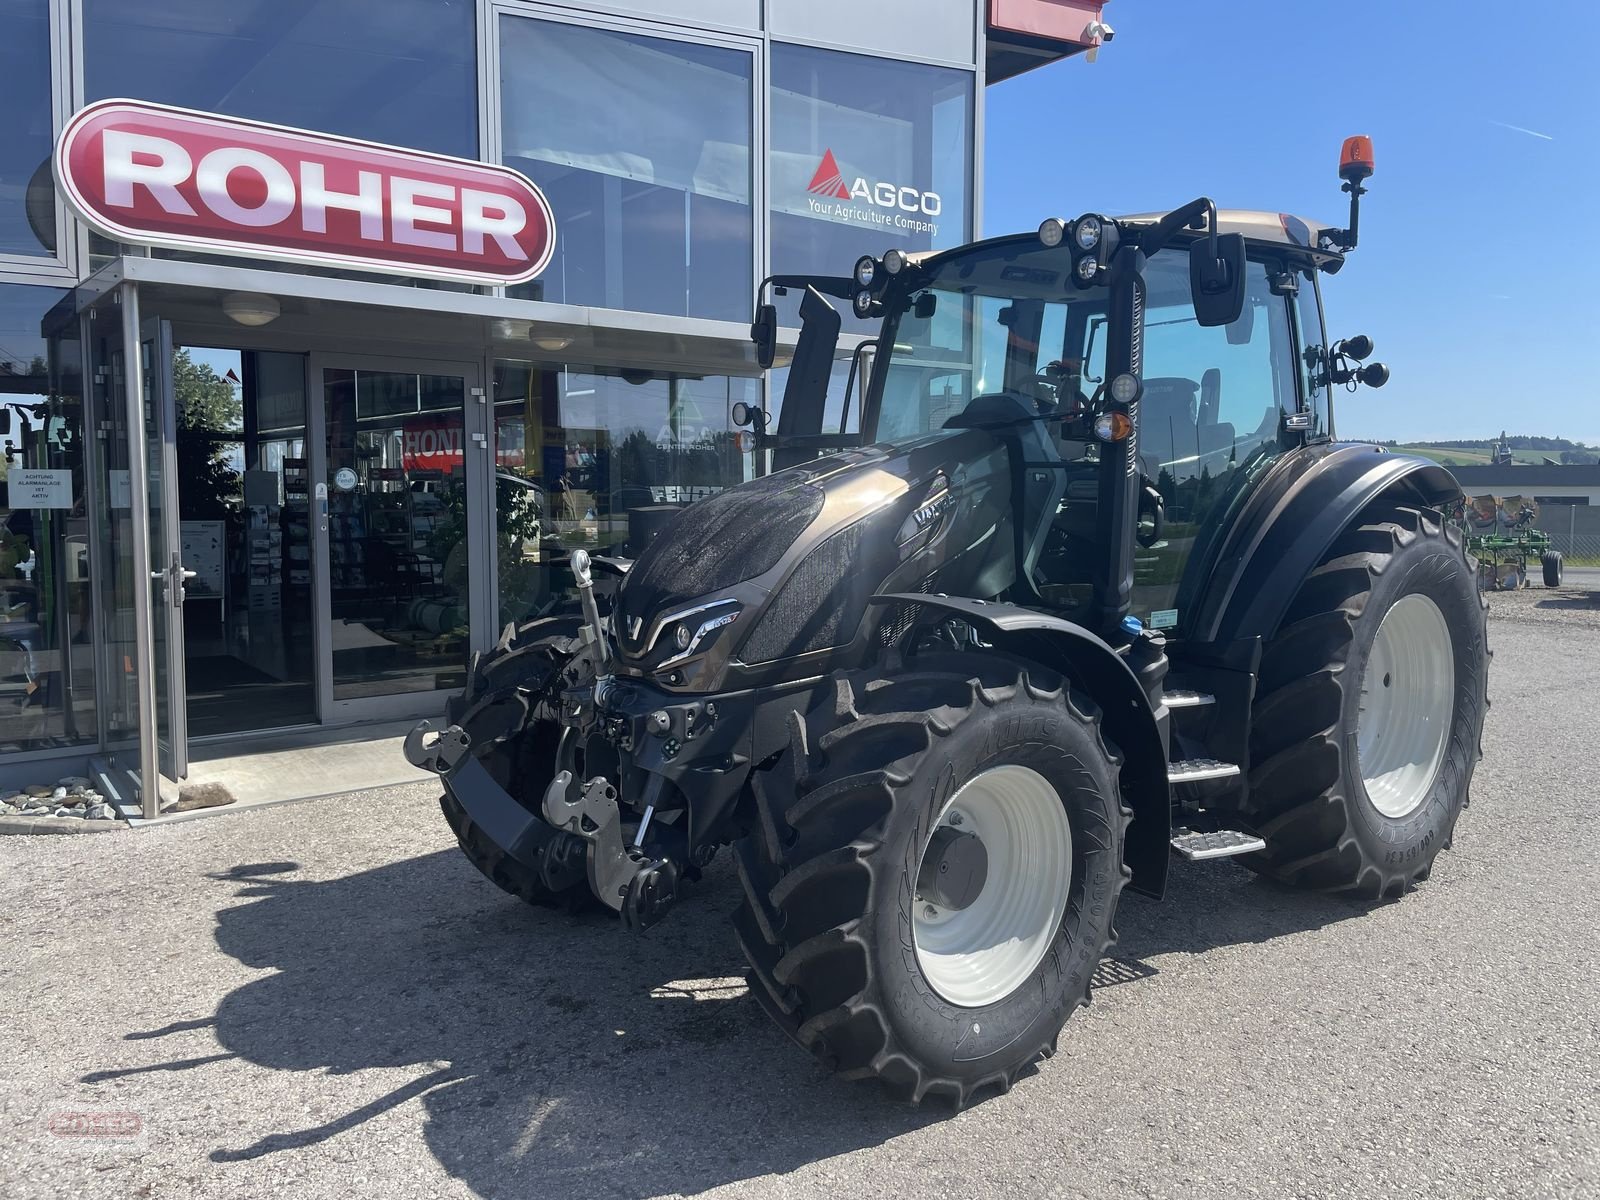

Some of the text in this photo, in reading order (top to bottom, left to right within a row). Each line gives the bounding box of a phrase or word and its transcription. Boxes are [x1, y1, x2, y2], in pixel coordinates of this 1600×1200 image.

[102, 128, 529, 261] ROHER
[850, 177, 941, 216] AGCO
[808, 198, 938, 236] Your Agriculture Company
[688, 444, 715, 452] ROHER
